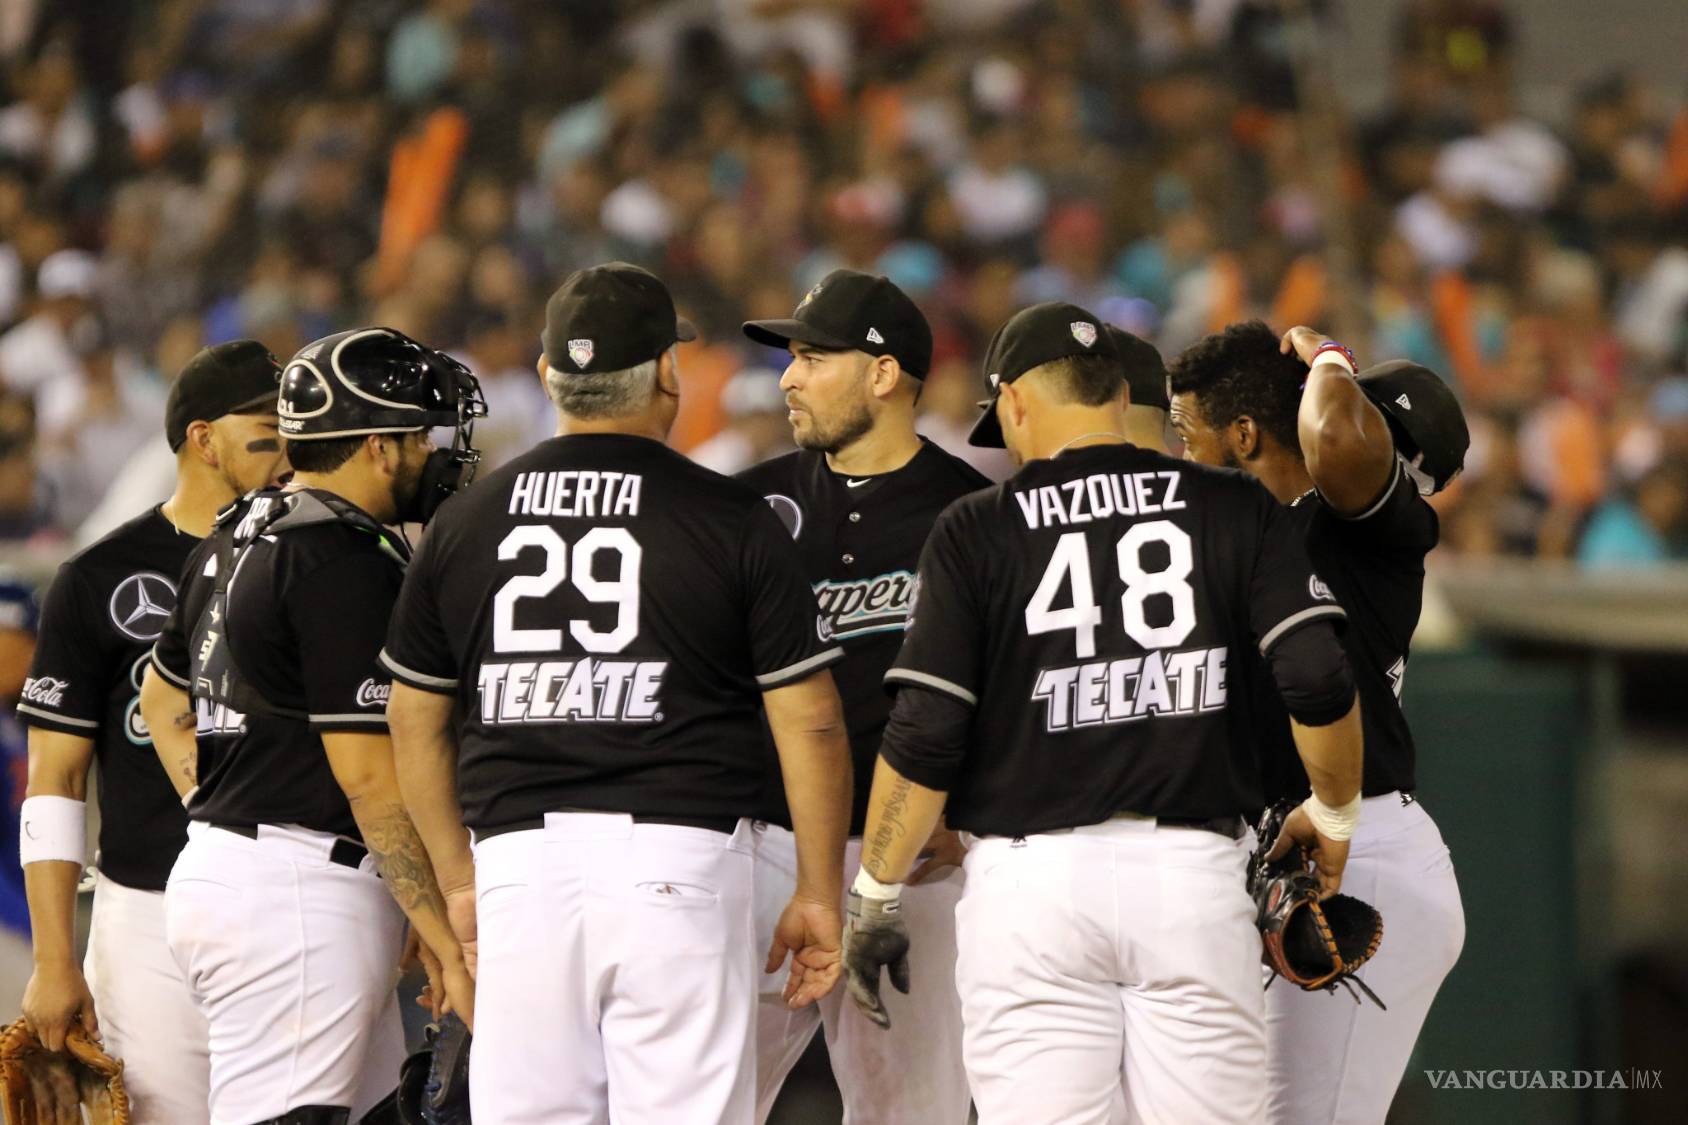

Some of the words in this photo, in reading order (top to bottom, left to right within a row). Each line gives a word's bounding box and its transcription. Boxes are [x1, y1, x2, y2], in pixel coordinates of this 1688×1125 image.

[508, 471, 642, 516] HUERTA
[1015, 471, 1186, 529] VAZQUEZ
[494, 525, 642, 653] 29
[1025, 520, 1197, 659] 48
[477, 656, 668, 724] TECATE
[1031, 646, 1228, 733] TECATE
